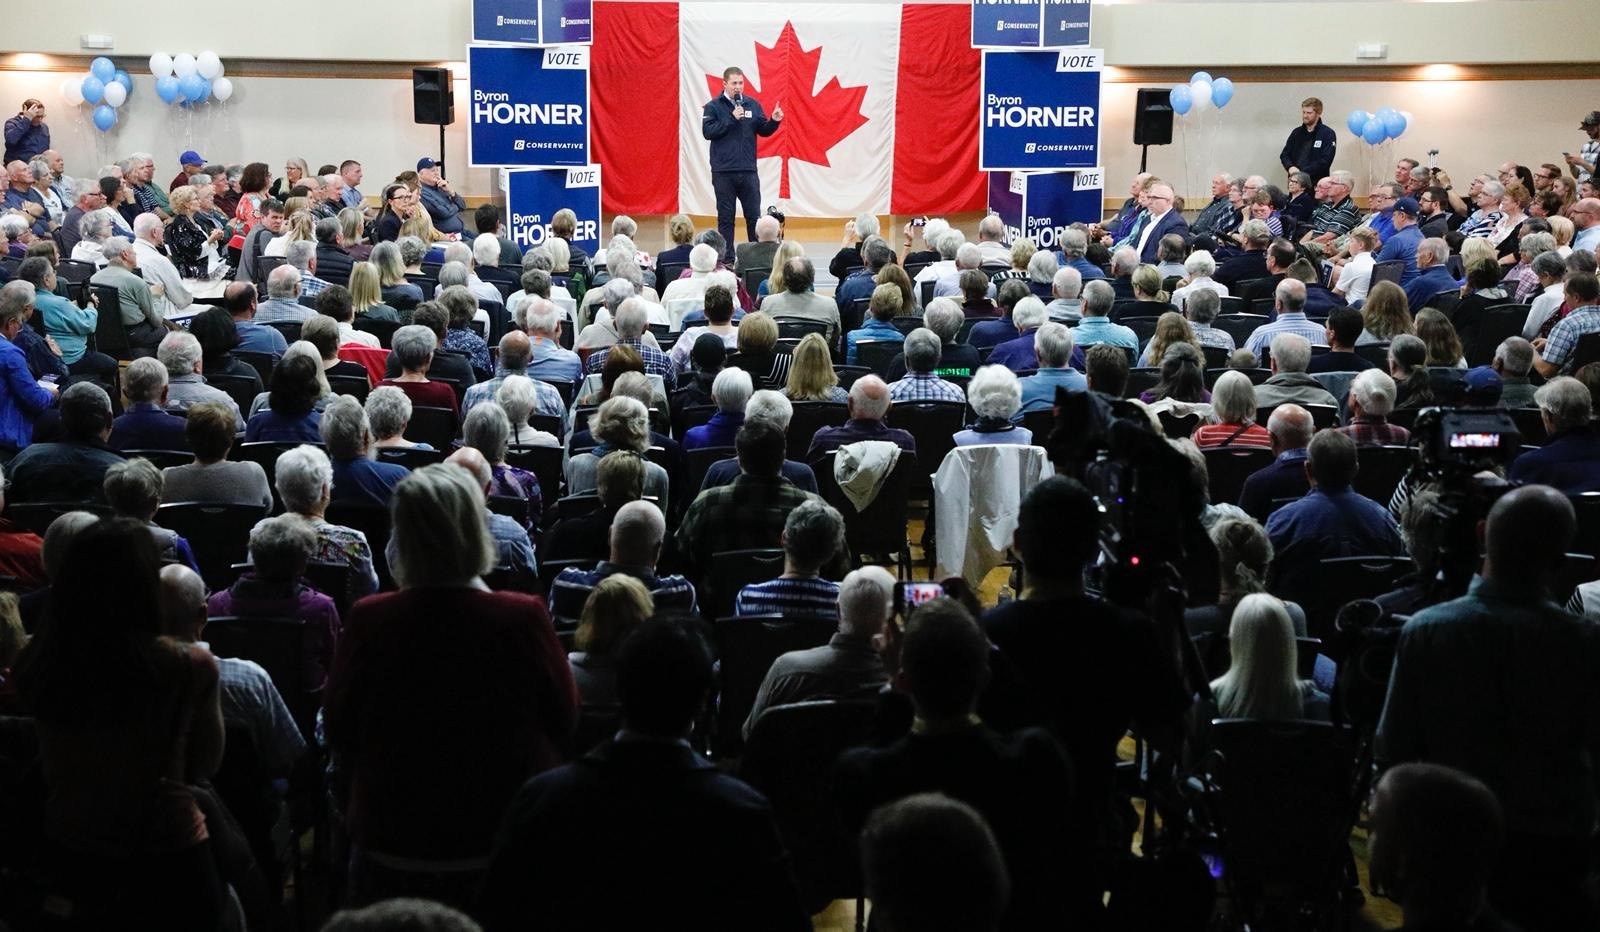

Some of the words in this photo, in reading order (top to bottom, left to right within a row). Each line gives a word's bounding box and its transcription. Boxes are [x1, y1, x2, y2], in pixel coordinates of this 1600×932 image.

[504, 18, 536, 26] CONSERVATIVE
[548, 52, 582, 65] VOTE
[1062, 55, 1095, 68] VOTE
[474, 90, 509, 103] Byron
[987, 93, 1022, 107] Byron
[474, 103, 583, 125] HORNER
[987, 107, 1094, 128] HORNER
[526, 142, 584, 150] CONSERVATIVE
[570, 171, 595, 184] VOTE
[1075, 173, 1099, 187] VOTE
[512, 213, 541, 227] Byron
[1027, 216, 1052, 229] Byron
[513, 220, 597, 246] HORER
